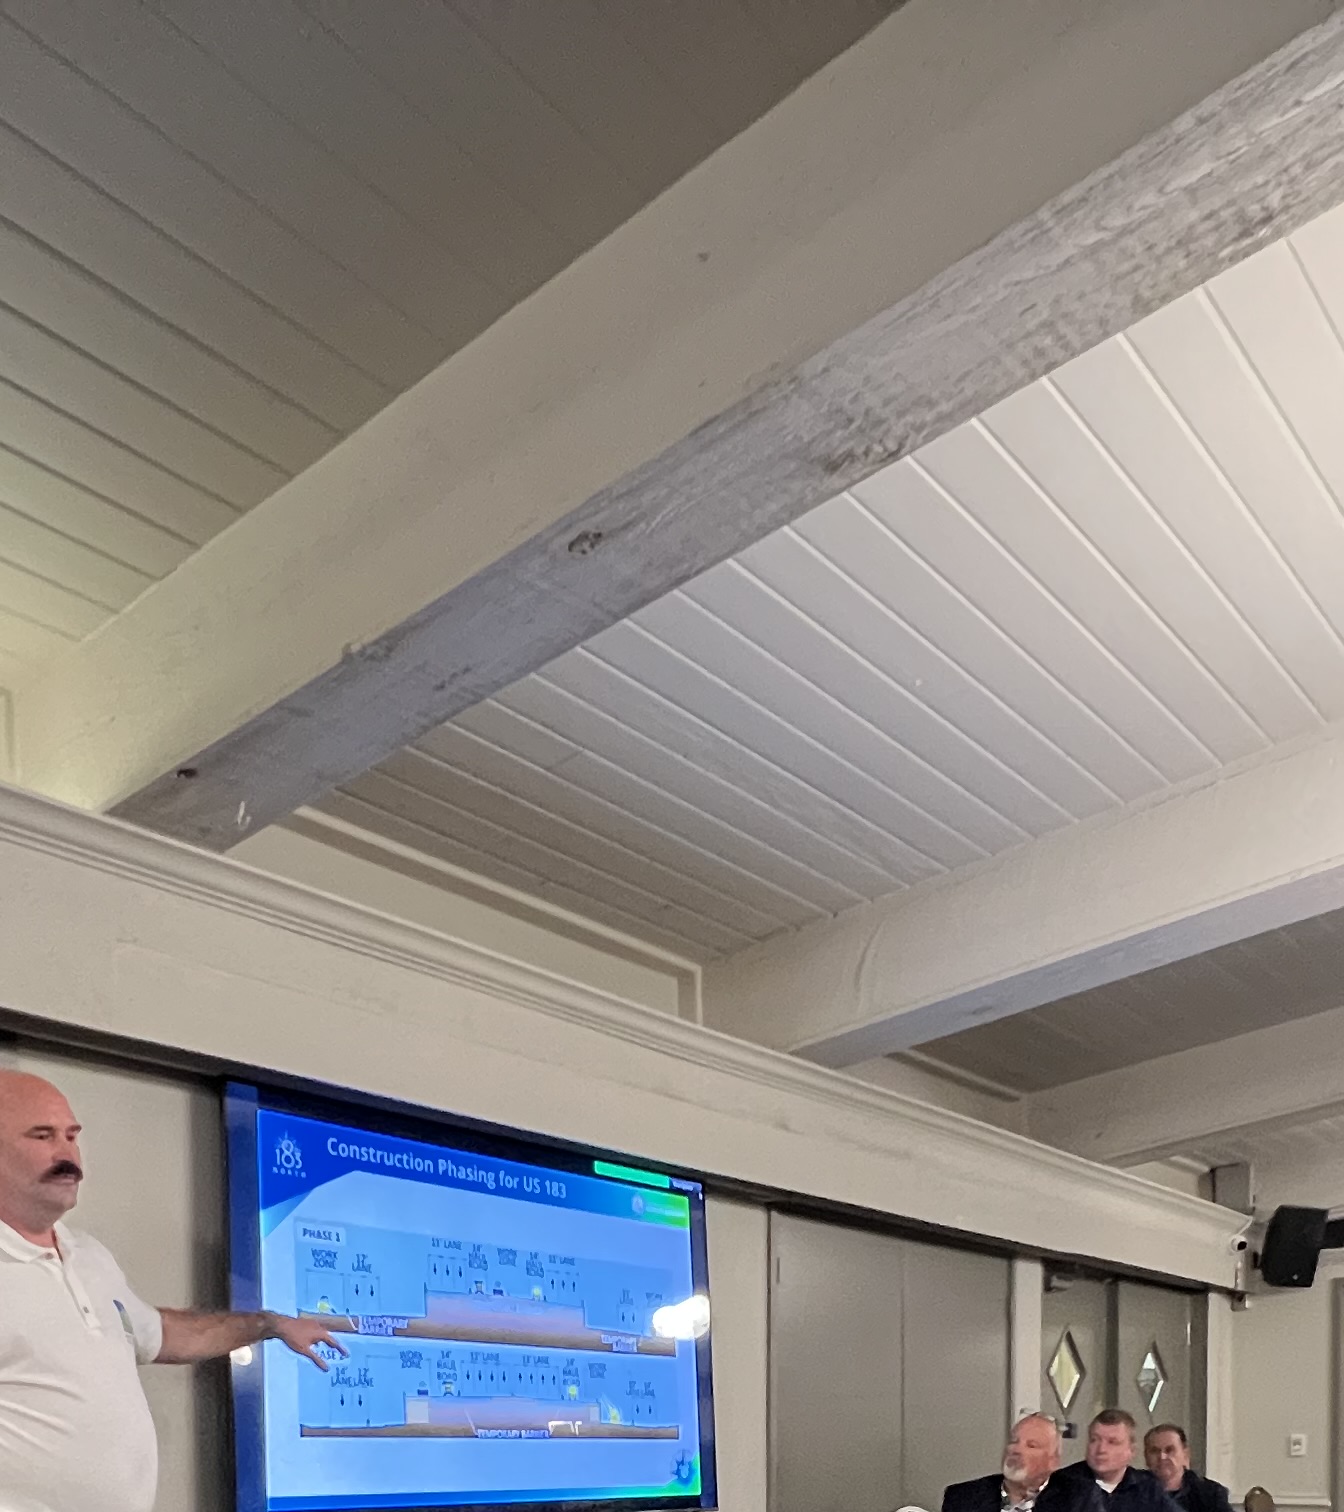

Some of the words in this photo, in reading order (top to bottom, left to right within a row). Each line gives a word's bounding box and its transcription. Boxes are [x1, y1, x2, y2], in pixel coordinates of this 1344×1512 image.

[275, 1139, 303, 1169] 183
[327, 1137, 434, 1173] Construction
[438, 1158, 496, 1190] Phasing
[499, 1170, 519, 1189] for
[523, 1176, 541, 1194] US
[545, 1180, 567, 1200] 183
[302, 1227, 333, 1241] PHASE
